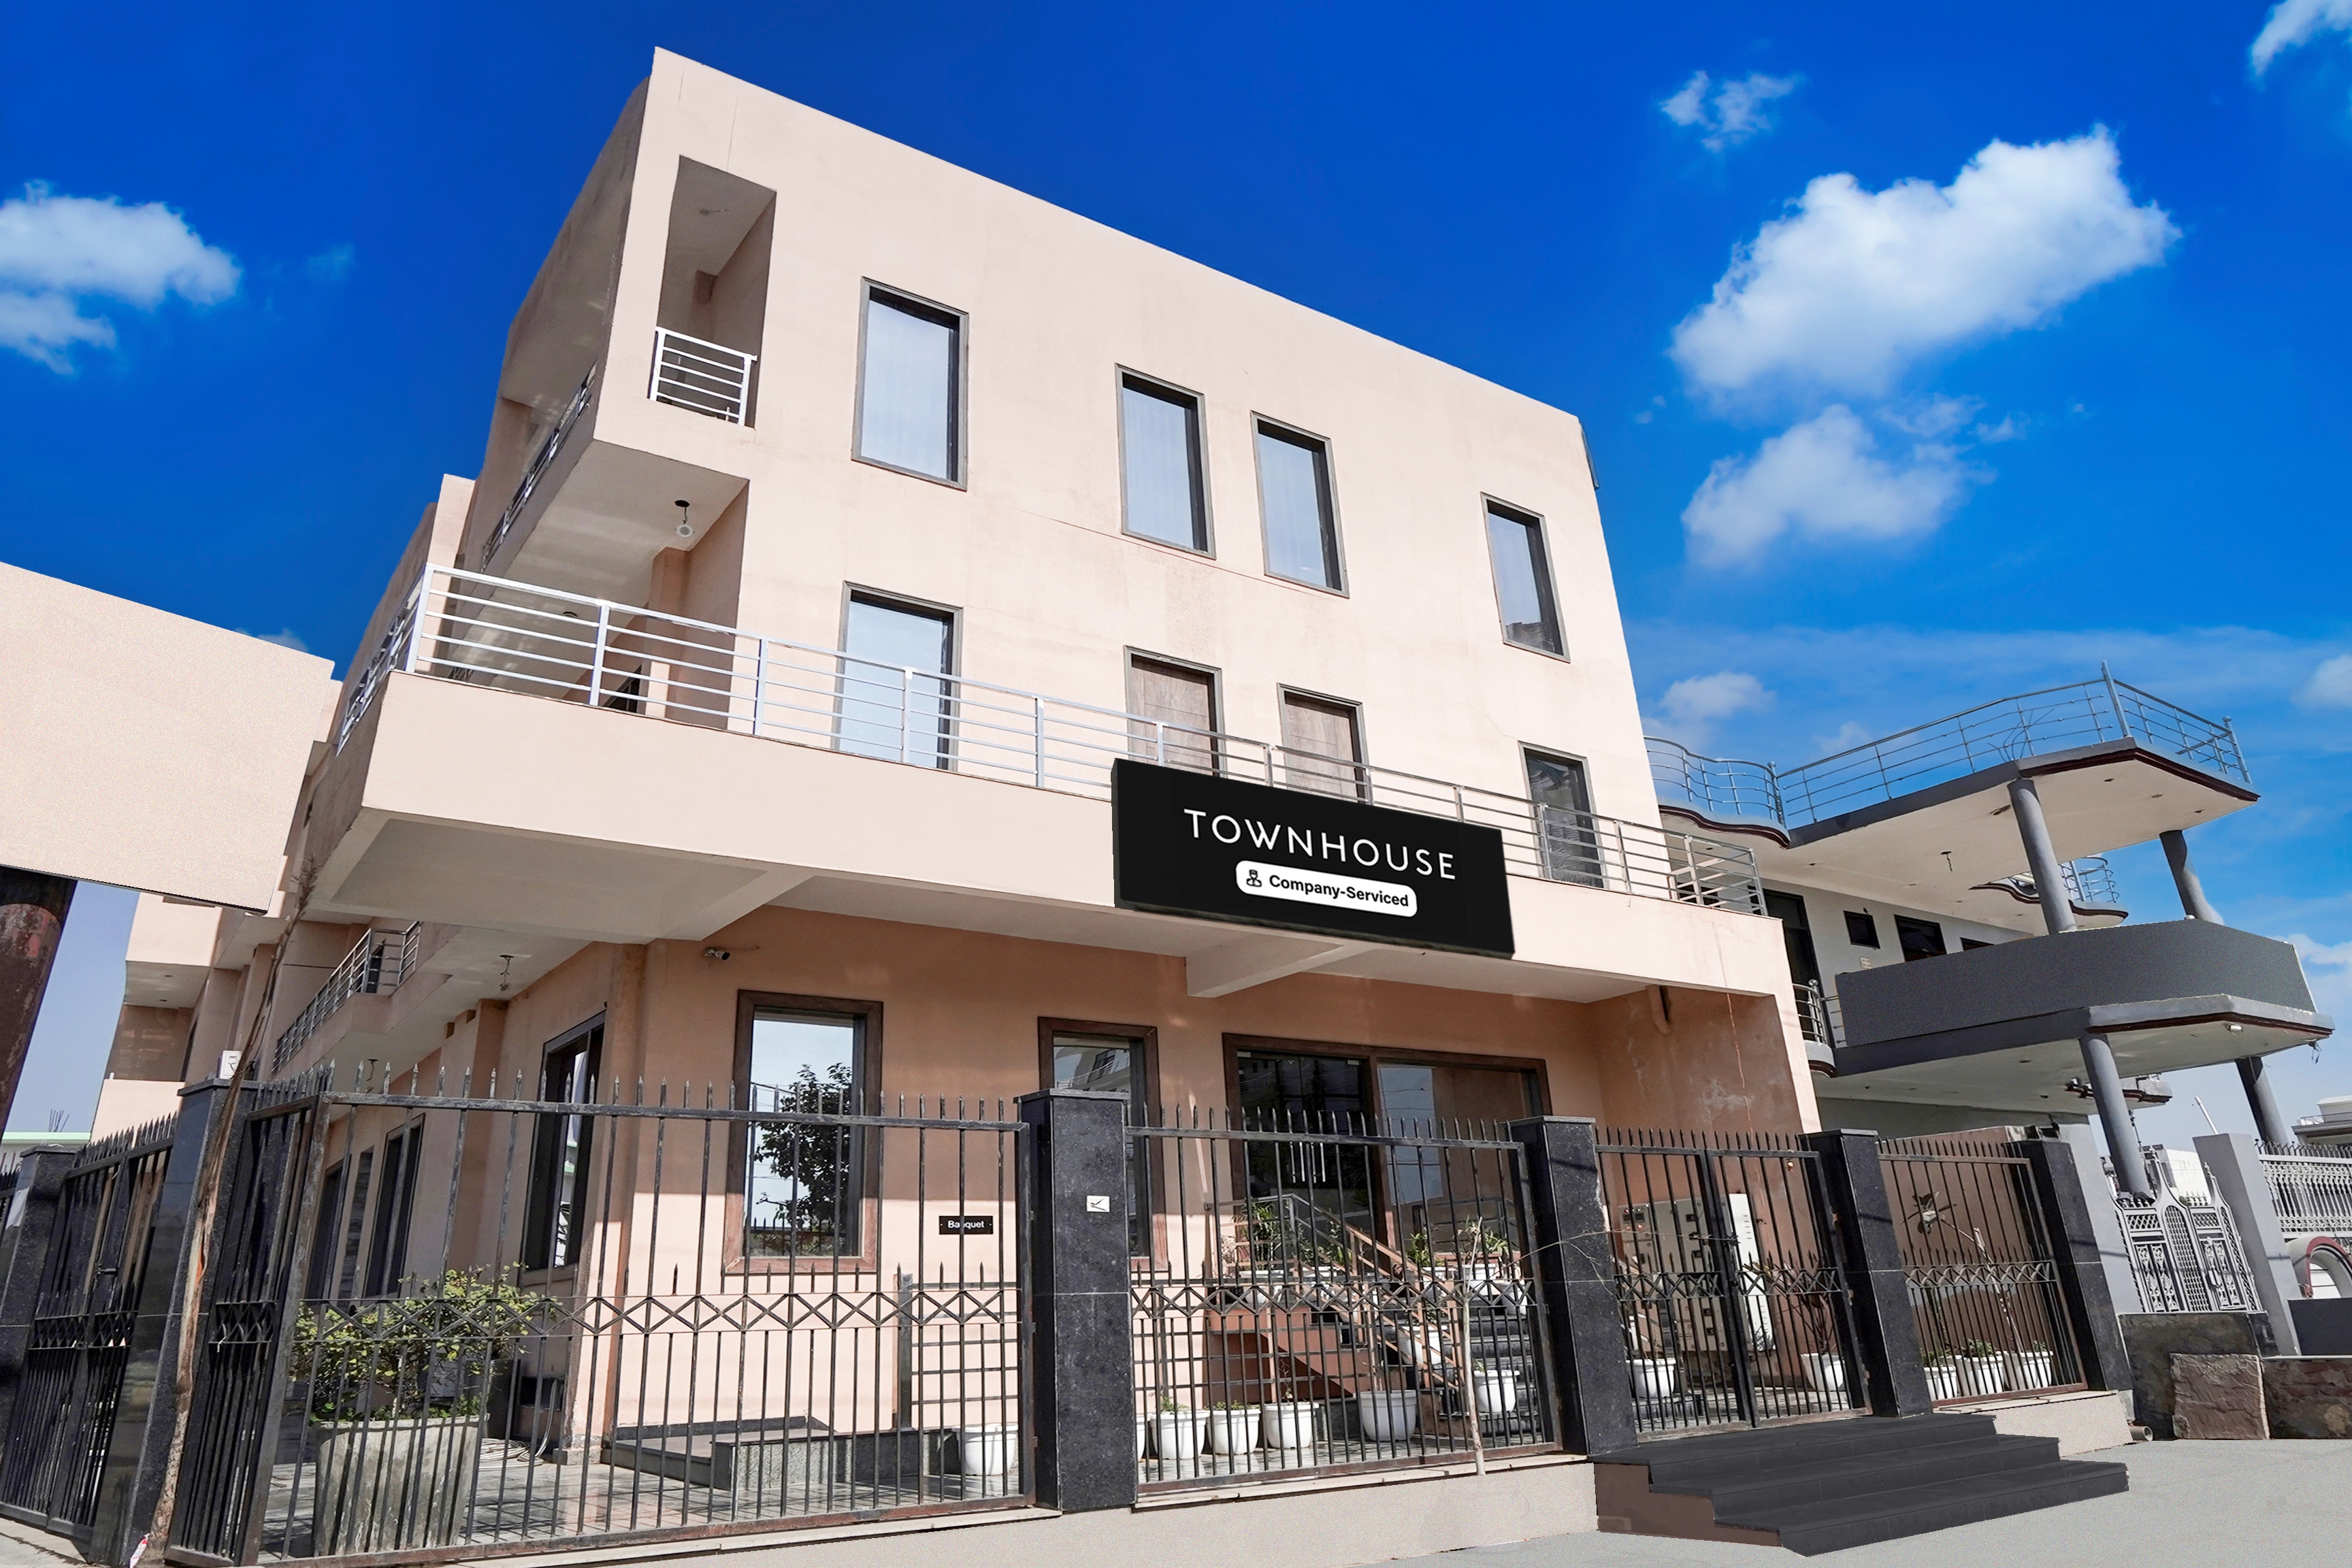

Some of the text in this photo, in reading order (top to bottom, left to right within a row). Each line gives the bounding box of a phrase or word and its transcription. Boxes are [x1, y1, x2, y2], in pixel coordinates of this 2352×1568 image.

[1184, 808, 1456, 880] TOWNHOUSE
[1269, 875, 1409, 907] Company-Serviced
[947, 1220, 985, 1230] Baquet
